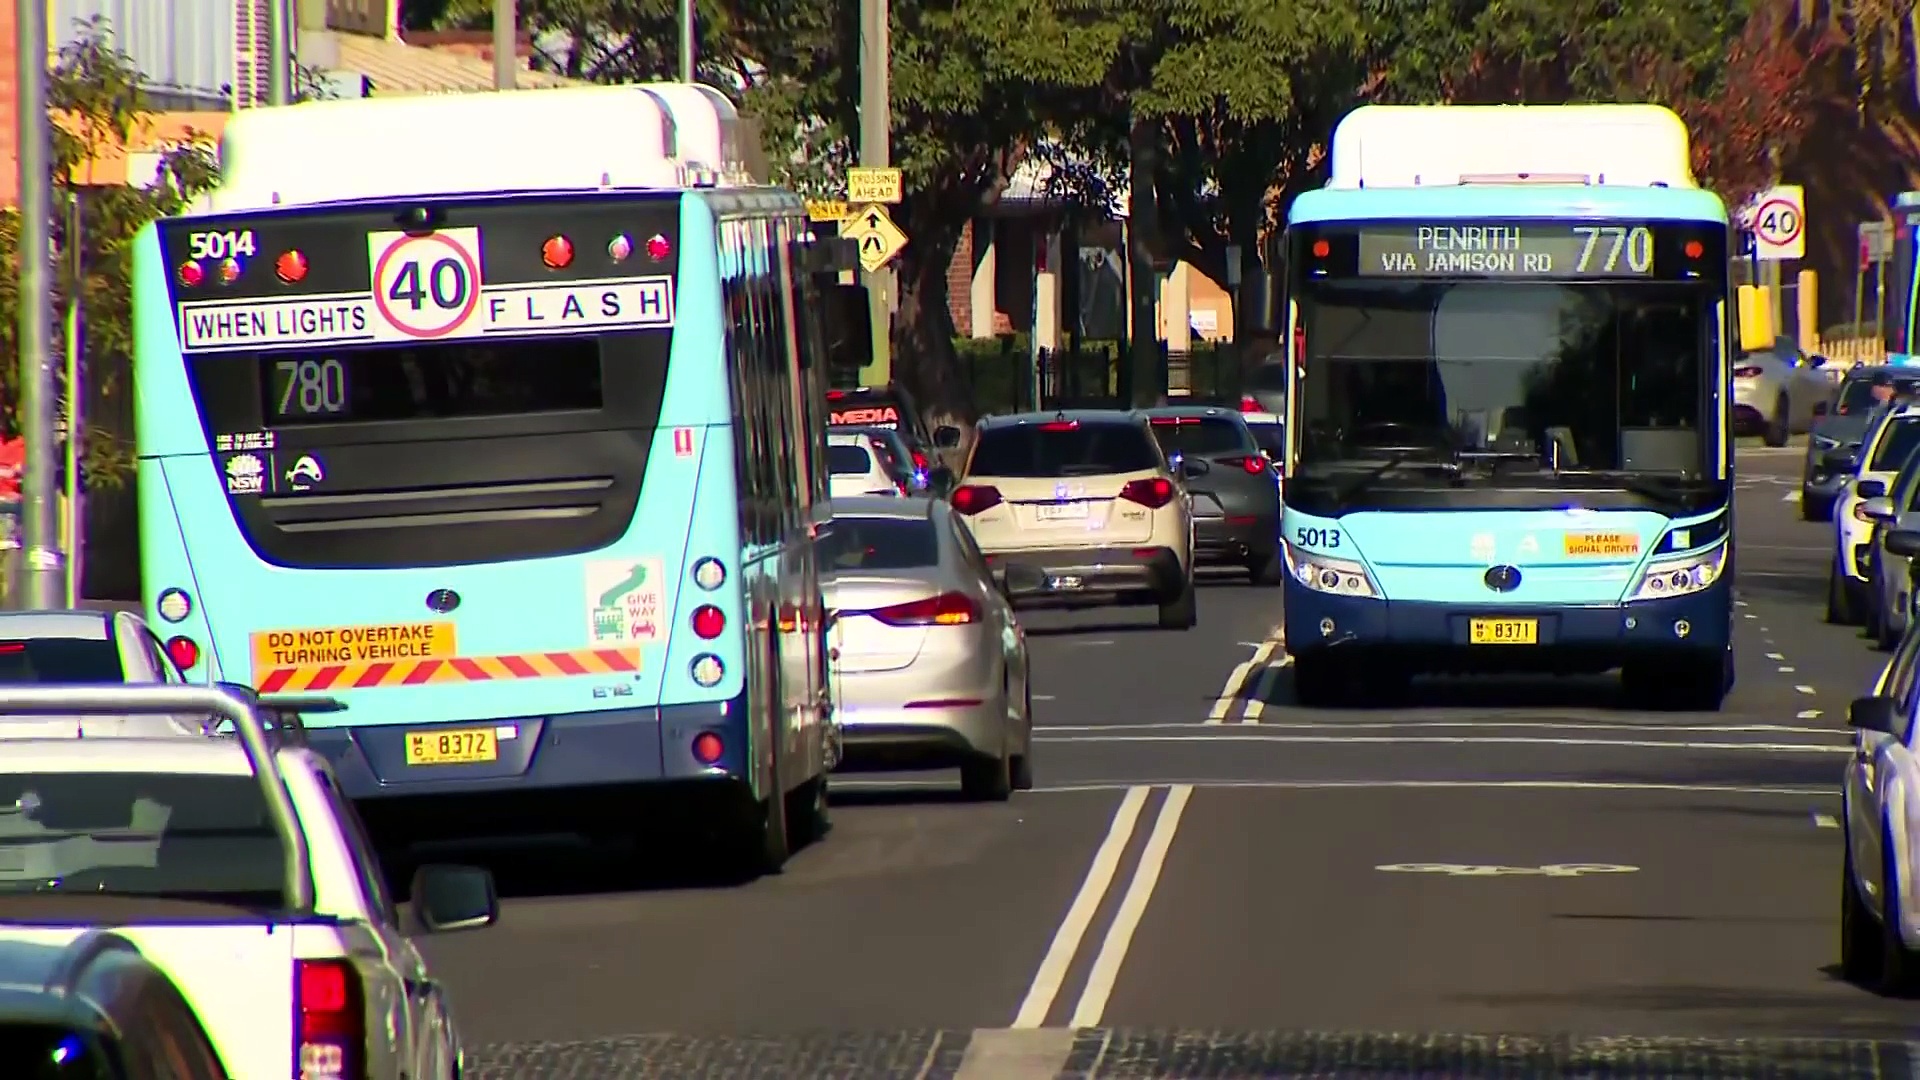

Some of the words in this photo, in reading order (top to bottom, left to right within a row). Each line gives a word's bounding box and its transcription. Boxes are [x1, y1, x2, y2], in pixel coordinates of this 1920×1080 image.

[852, 174, 897, 184] CROSSING
[855, 188, 893, 198] AHEAD
[1762, 211, 1796, 234] 40
[190, 231, 255, 259] 5014
[1418, 227, 1519, 250] PENRITH
[1573, 227, 1652, 272] 770
[1382, 254, 1416, 271] VIA
[1425, 254, 1515, 271] JAMISON
[1524, 254, 1552, 271] RD
[389, 258, 466, 311] 40
[491, 290, 662, 322] FLASH
[194, 310, 267, 340] WHEN
[278, 305, 365, 335] LIGHTS
[277, 359, 345, 414] 780
[831, 408, 898, 425] MEDIA
[228, 476, 263, 489] NSW
[1297, 528, 1340, 547] 5013
[1585, 535, 1621, 543] PLEASE
[1569, 545, 1600, 554] SIGNAL
[1604, 544, 1638, 553] DRIVER
[628, 594, 656, 604] GIVE
[629, 607, 656, 618] WAY
[269, 633, 295, 649] DO
[300, 630, 336, 646] NOT
[341, 625, 435, 643] OVERTAKE
[1495, 623, 1529, 638] 8371
[273, 646, 352, 664] TURNING
[357, 642, 432, 659] VEHICLE
[439, 733, 487, 755] 8372
